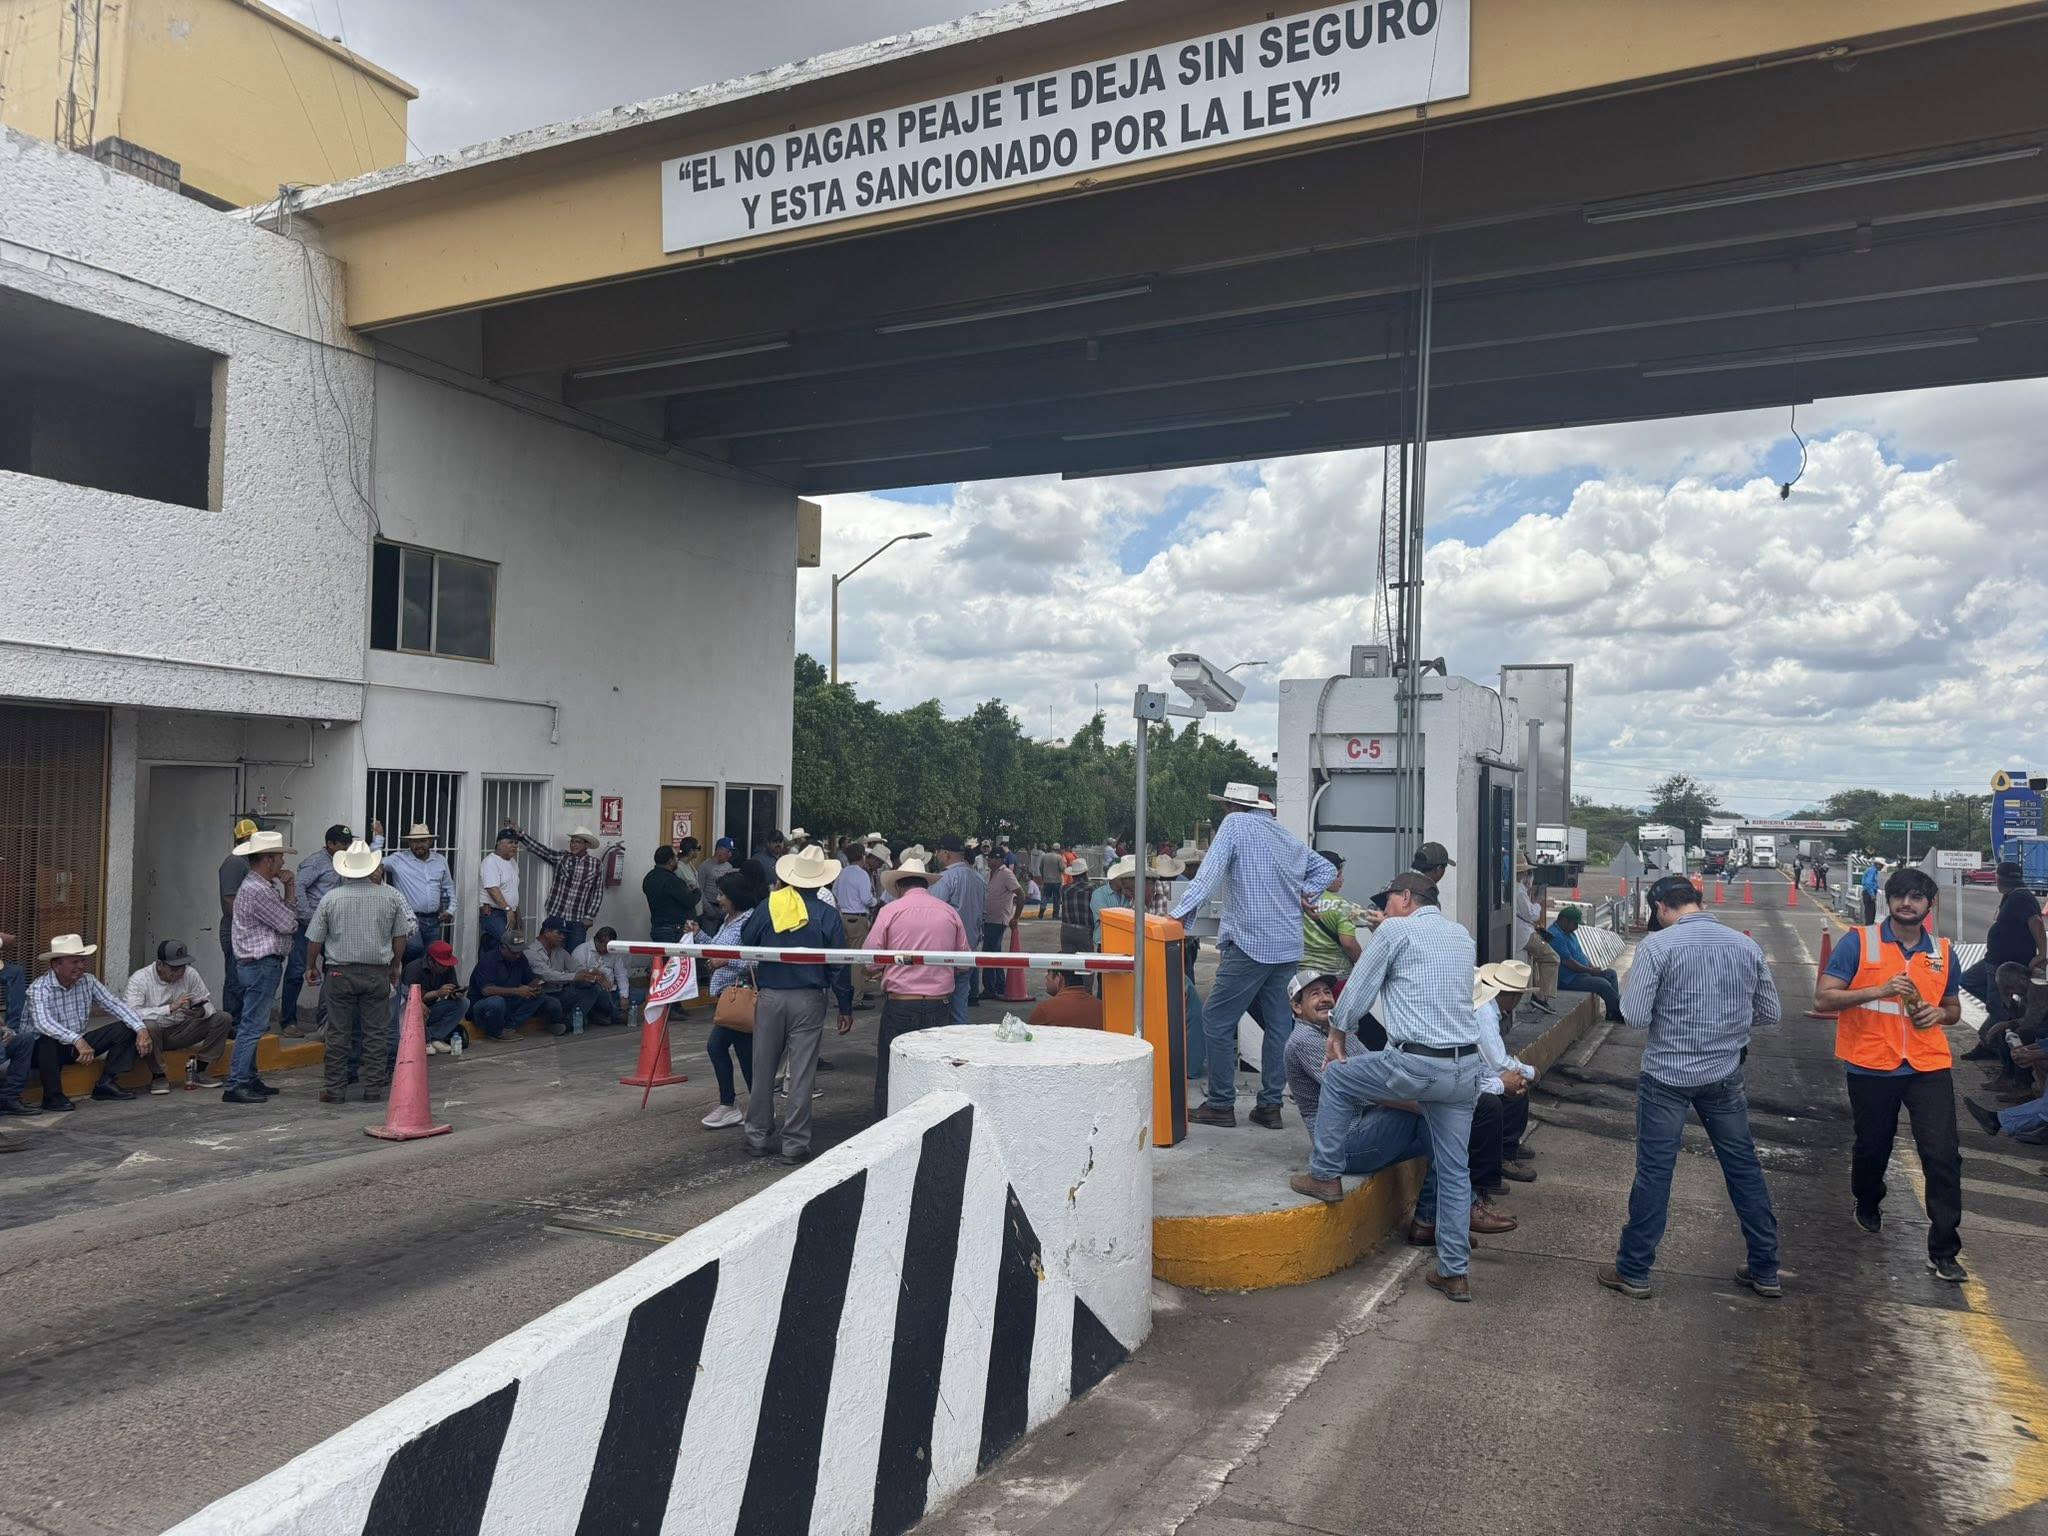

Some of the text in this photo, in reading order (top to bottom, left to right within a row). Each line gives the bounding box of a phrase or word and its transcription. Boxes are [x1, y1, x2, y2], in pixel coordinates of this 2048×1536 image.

[678, 0, 1438, 193] “EL NO PAGAR PEAJE TE DEJA SIN SEGURO
[741, 72, 1341, 230] Y ESTA SANCIONADO POR LA LEY”
[1346, 738, 1382, 760] C-5
